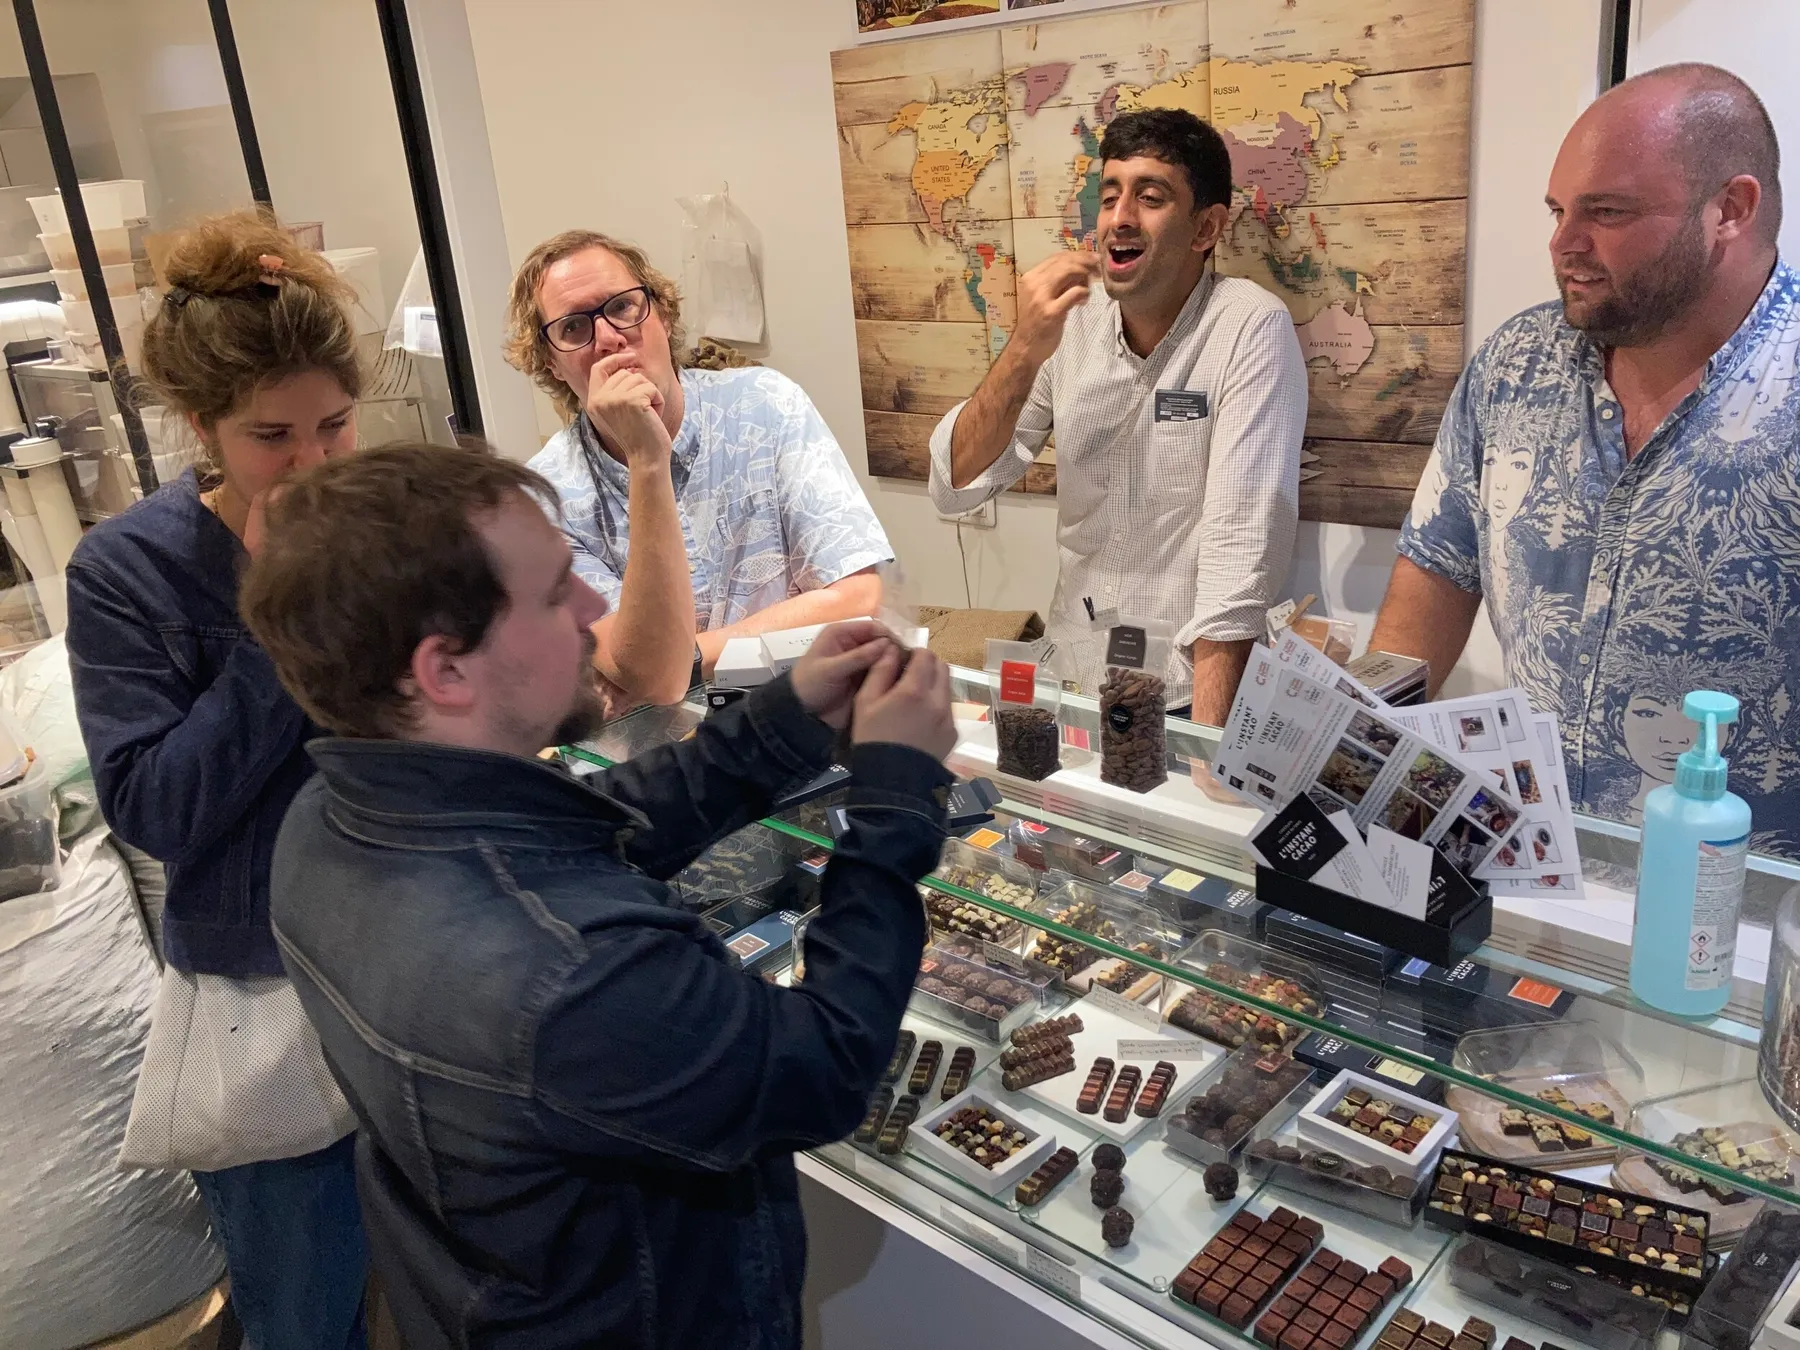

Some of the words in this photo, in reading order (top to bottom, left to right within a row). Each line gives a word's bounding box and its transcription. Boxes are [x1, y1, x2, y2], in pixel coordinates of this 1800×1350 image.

[1213, 86, 1240, 96] RUSSIA
[1308, 341, 1352, 349] AUSTRALIA
[1367, 664, 1395, 678] CACAO
[1236, 706, 1253, 750] L'INSTANT
[1258, 711, 1280, 745] L'INSTANT
[1268, 721, 1285, 743] CACAO
[1278, 821, 1317, 859] L'INSTANT
[1291, 835, 1317, 861] CACAO
[1446, 959, 1469, 982] L'INSTAN
[1457, 962, 1475, 980] CACAO
